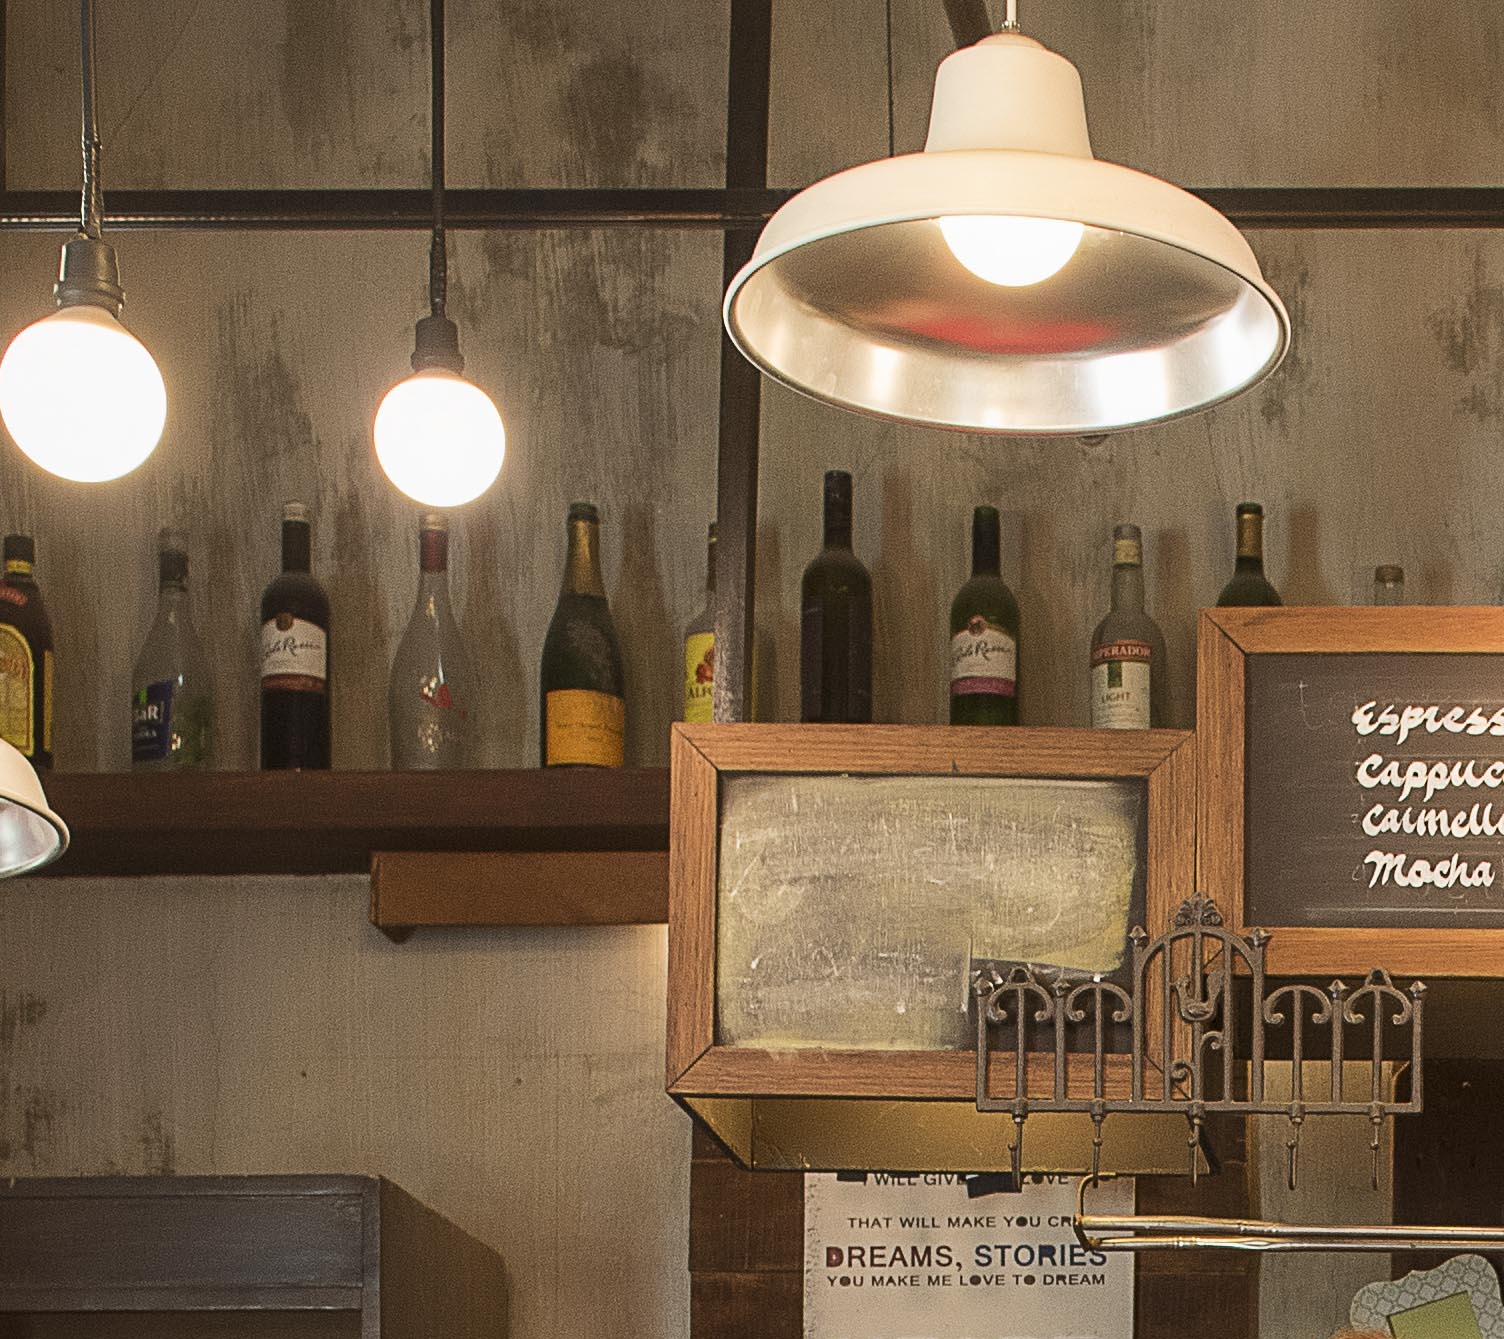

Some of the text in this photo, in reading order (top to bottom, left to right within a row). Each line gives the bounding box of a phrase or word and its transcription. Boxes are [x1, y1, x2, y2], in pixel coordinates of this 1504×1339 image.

[1364, 850, 1496, 888] Mocha
[847, 1216, 1077, 1228] THAT WILL MAKE YOU CR
[825, 1244, 1108, 1272] DREAMS, STORIES
[827, 1274, 1106, 1287] YOU MAKE ME LOVE TO DREAM
